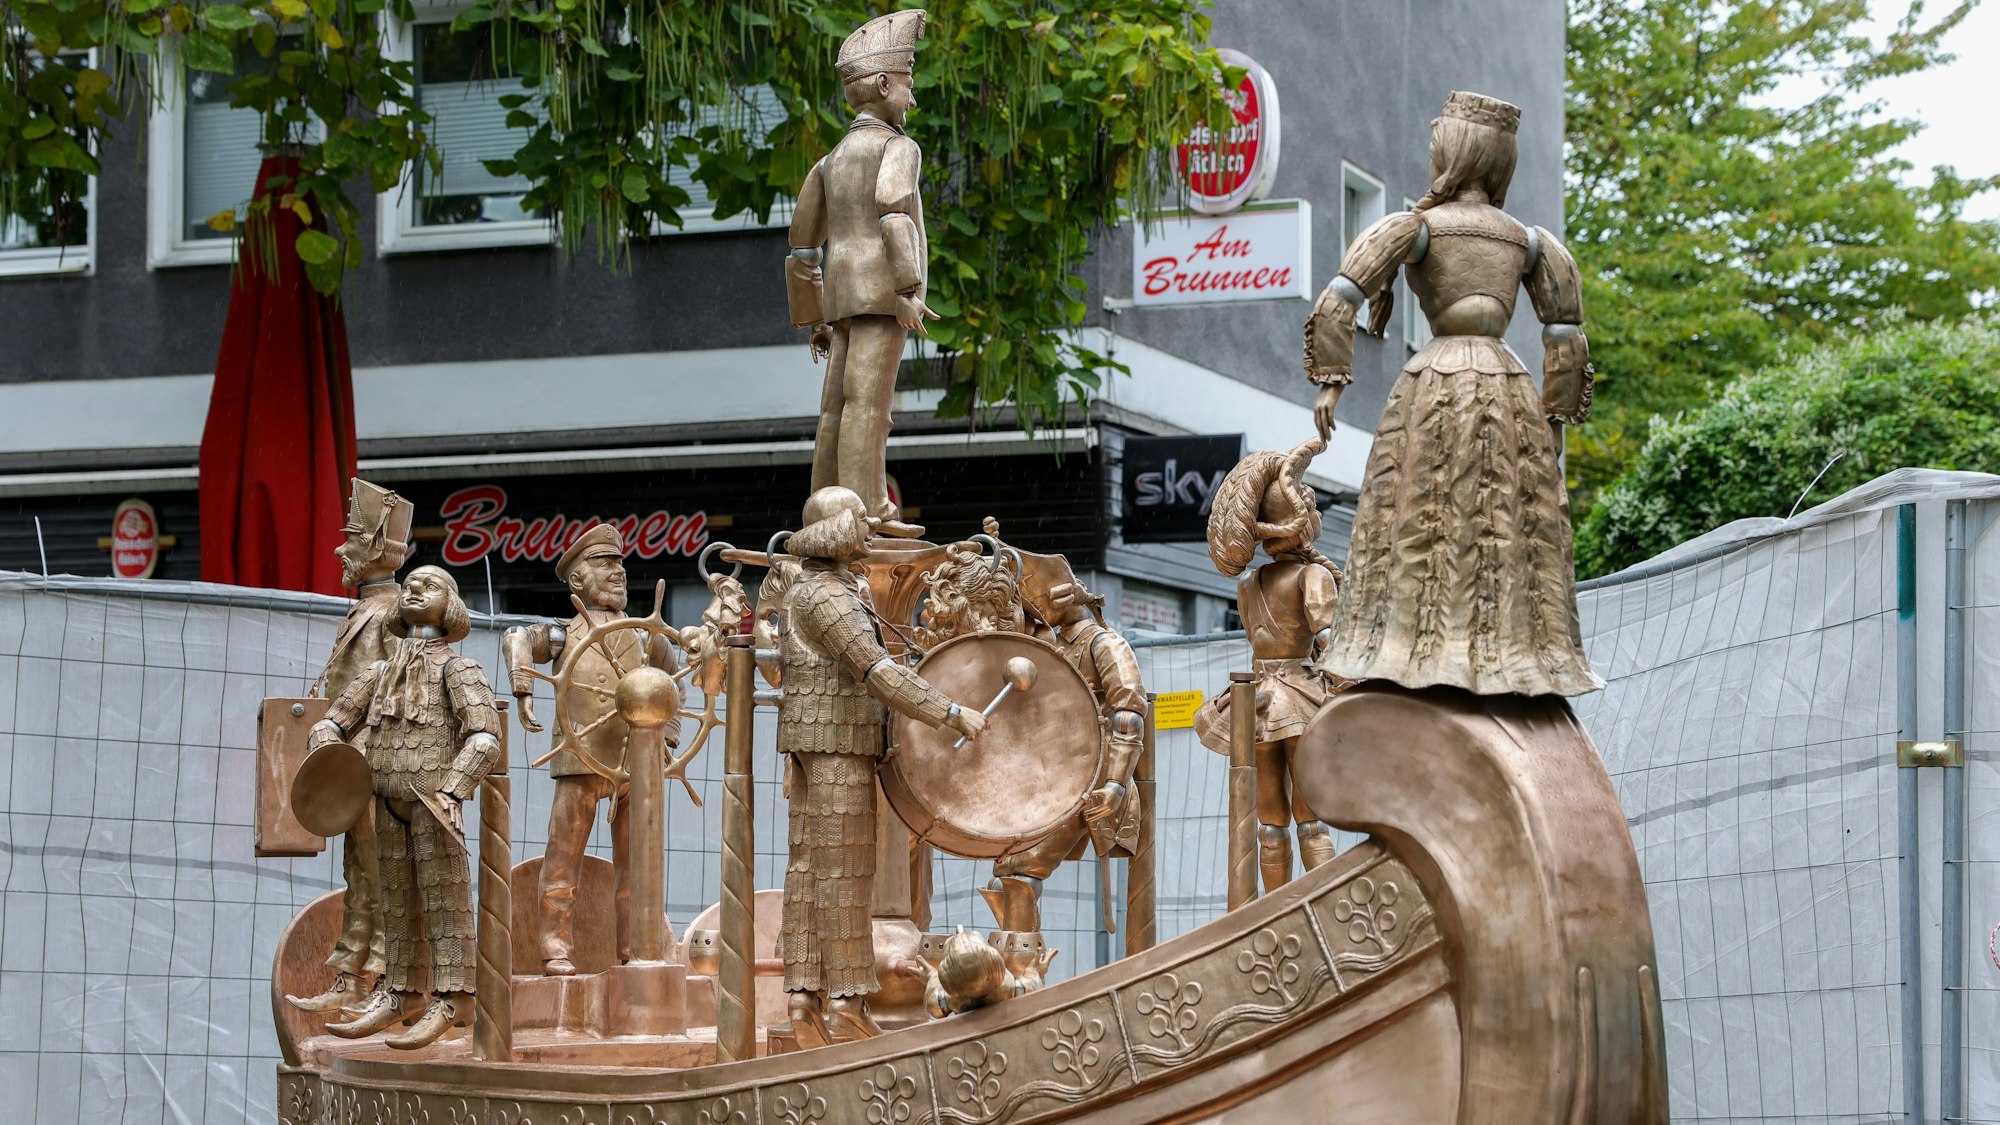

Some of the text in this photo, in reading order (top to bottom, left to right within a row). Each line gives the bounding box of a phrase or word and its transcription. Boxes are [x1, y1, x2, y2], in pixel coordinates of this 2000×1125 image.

[1182, 117, 1258, 145] eissorf
[1186, 224, 1252, 263] Am
[1143, 256, 1292, 296] Brunnen
[1134, 458, 1226, 516] sky
